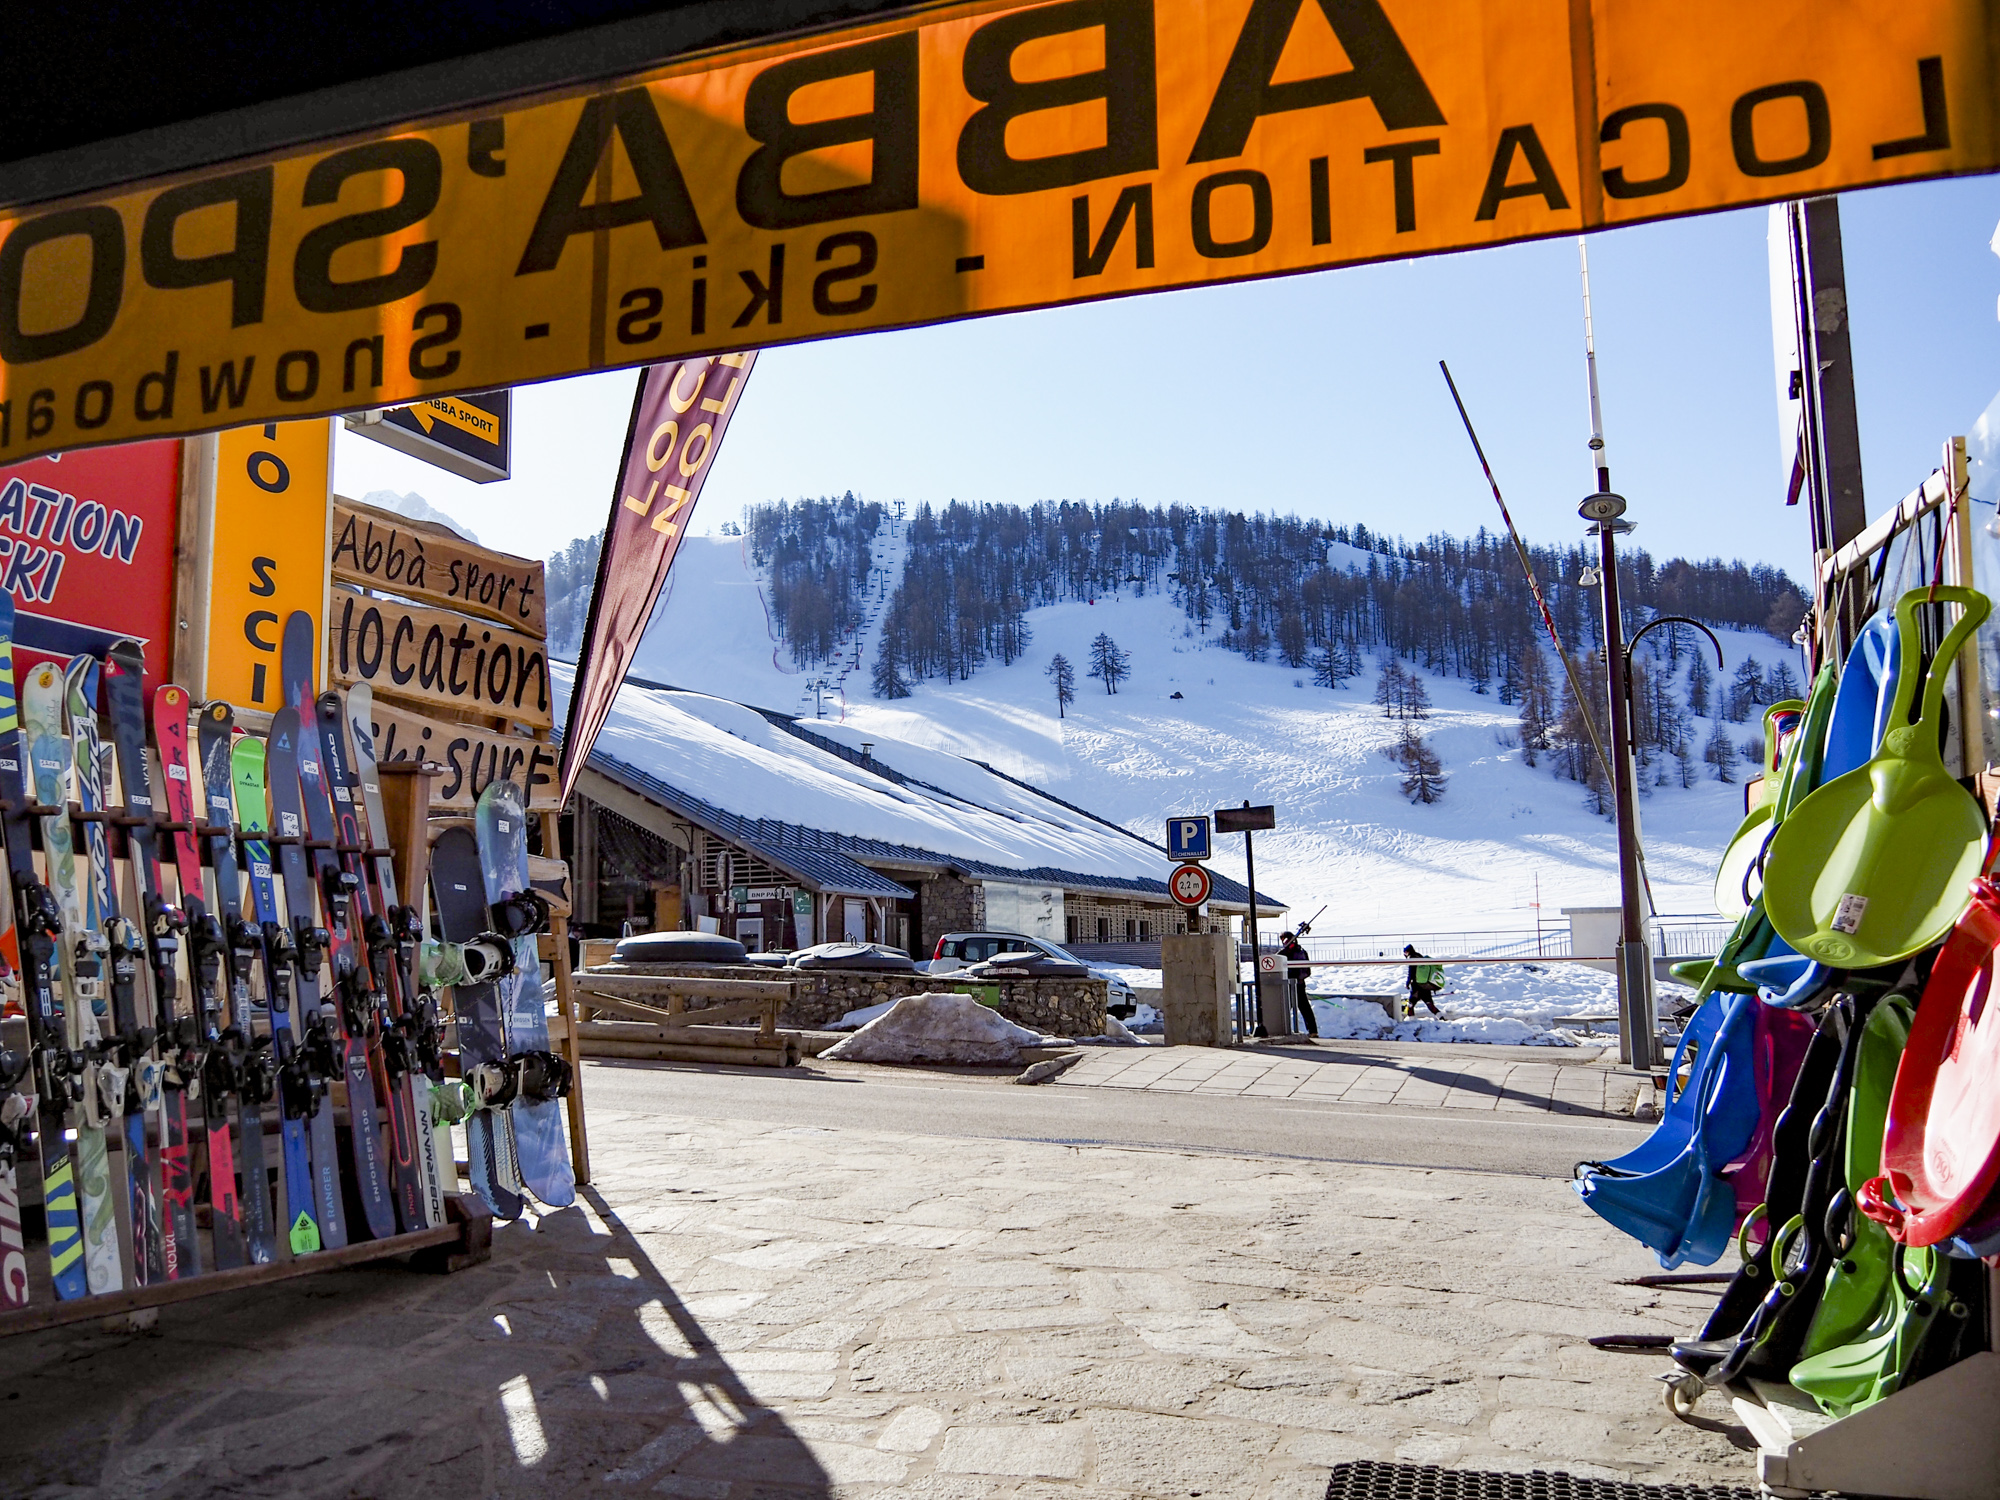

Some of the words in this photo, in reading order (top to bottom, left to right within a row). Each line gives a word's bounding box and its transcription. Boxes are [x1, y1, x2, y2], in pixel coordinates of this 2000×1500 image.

[459, 409, 493, 433] SPORT
[332, 514, 425, 588] Abbà
[448, 559, 534, 618] sport
[243, 556, 279, 703] SCI
[340, 597, 547, 713] location
[328, 732, 342, 780] HEAD
[1181, 821, 1199, 849] P
[1180, 880, 1191, 890] 2,2
[321, 1165, 335, 1218] RANGER
[365, 1136, 381, 1203] ENFORCER
